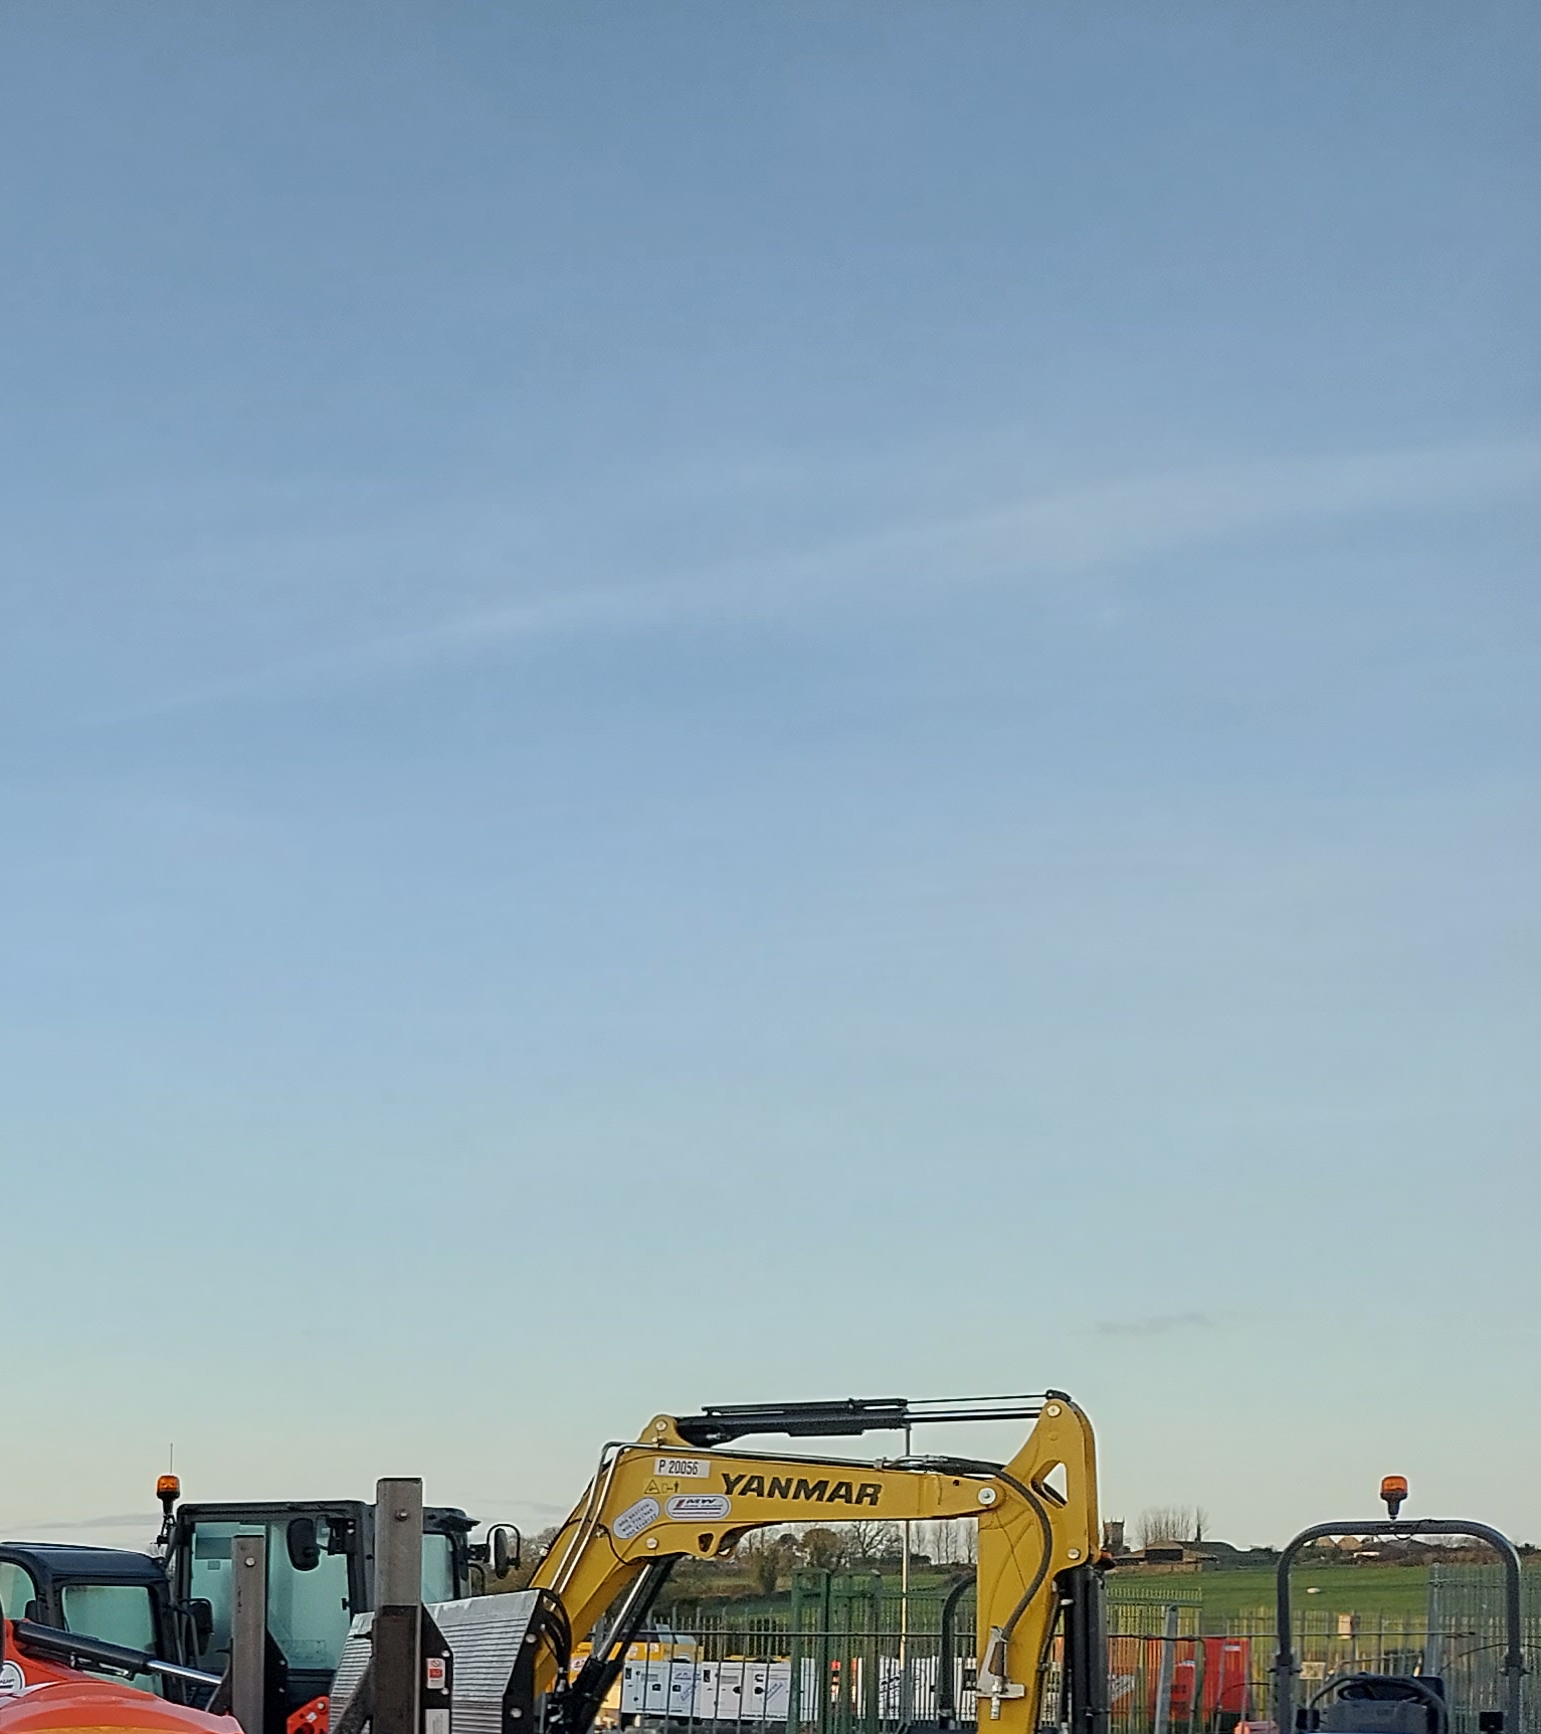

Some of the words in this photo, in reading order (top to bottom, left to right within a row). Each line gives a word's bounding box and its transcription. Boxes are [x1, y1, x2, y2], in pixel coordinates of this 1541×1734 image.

[658, 1458, 666, 1473] P
[668, 1459, 699, 1475] 20056
[721, 1473, 883, 1506] YANMAR
